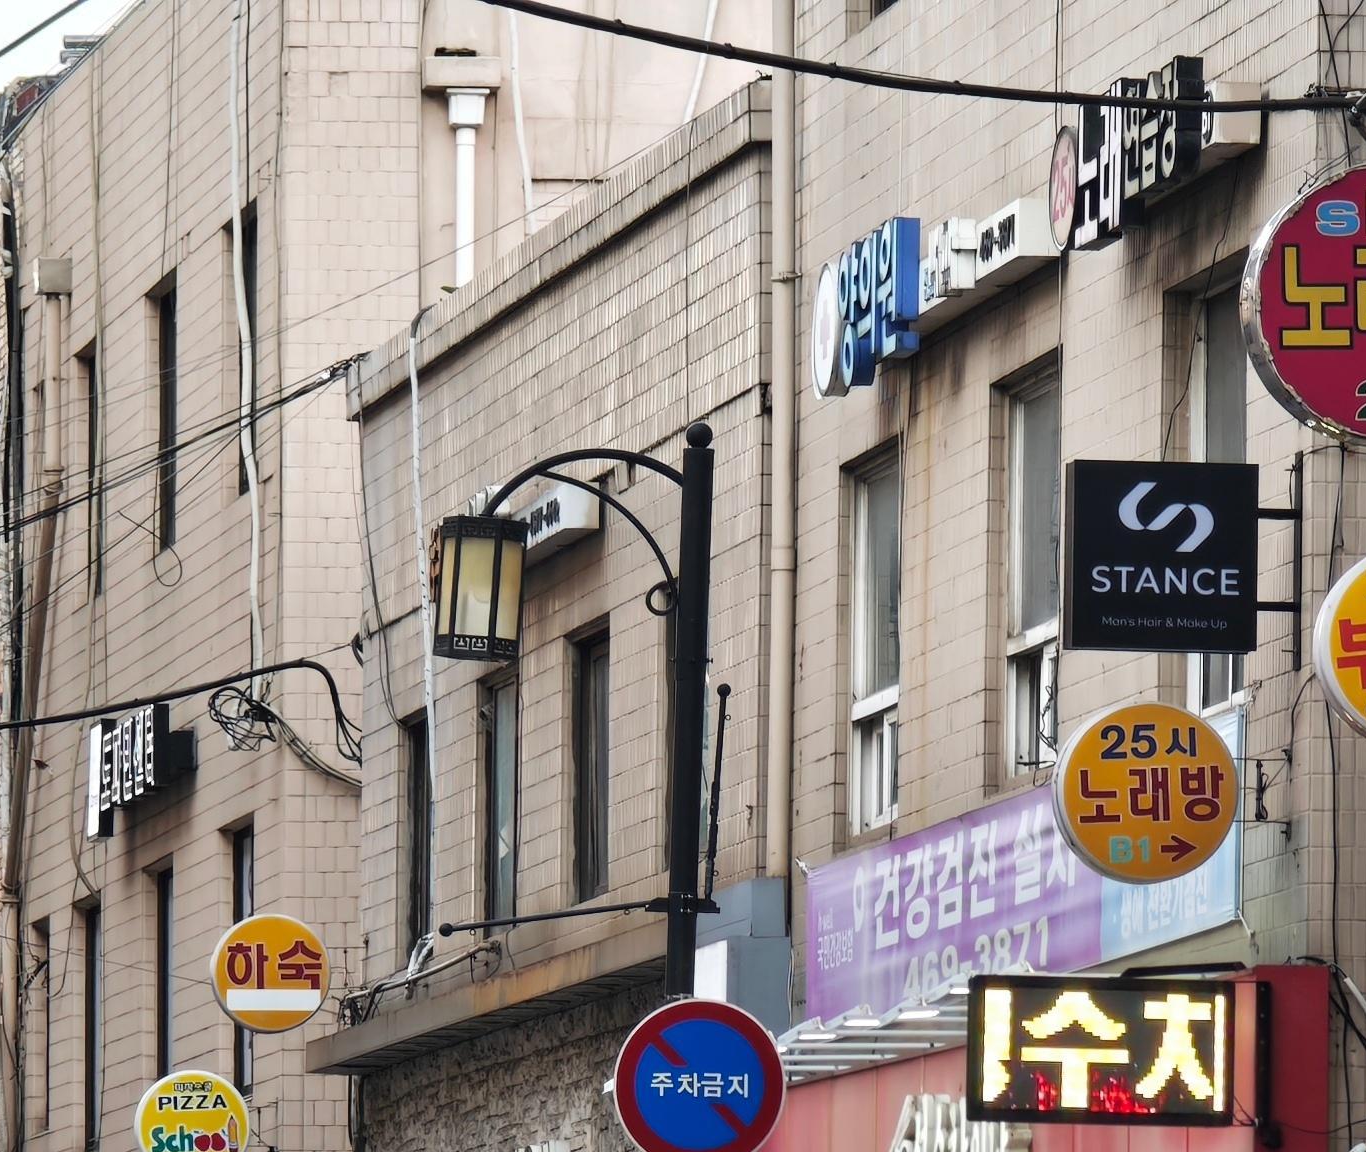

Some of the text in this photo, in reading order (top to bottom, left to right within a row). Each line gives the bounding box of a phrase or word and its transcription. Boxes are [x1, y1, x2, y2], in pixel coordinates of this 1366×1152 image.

[838, 219, 897, 386] 양의원
[1092, 565, 1240, 596] STANCE
[1138, 616, 1162, 628] Hair
[1166, 616, 1173, 629] &
[1176, 616, 1207, 629] Make
[1210, 618, 1228, 630] Up
[1100, 724, 1197, 760] 25시
[1078, 765, 1225, 825] 노래방
[1109, 836, 1150, 864] B1
[874, 820, 997, 950] 건강검진
[226, 940, 321, 989] 하숙
[650, 1072, 750, 1099] 주차금지
[158, 1095, 227, 1110] PIZZA
